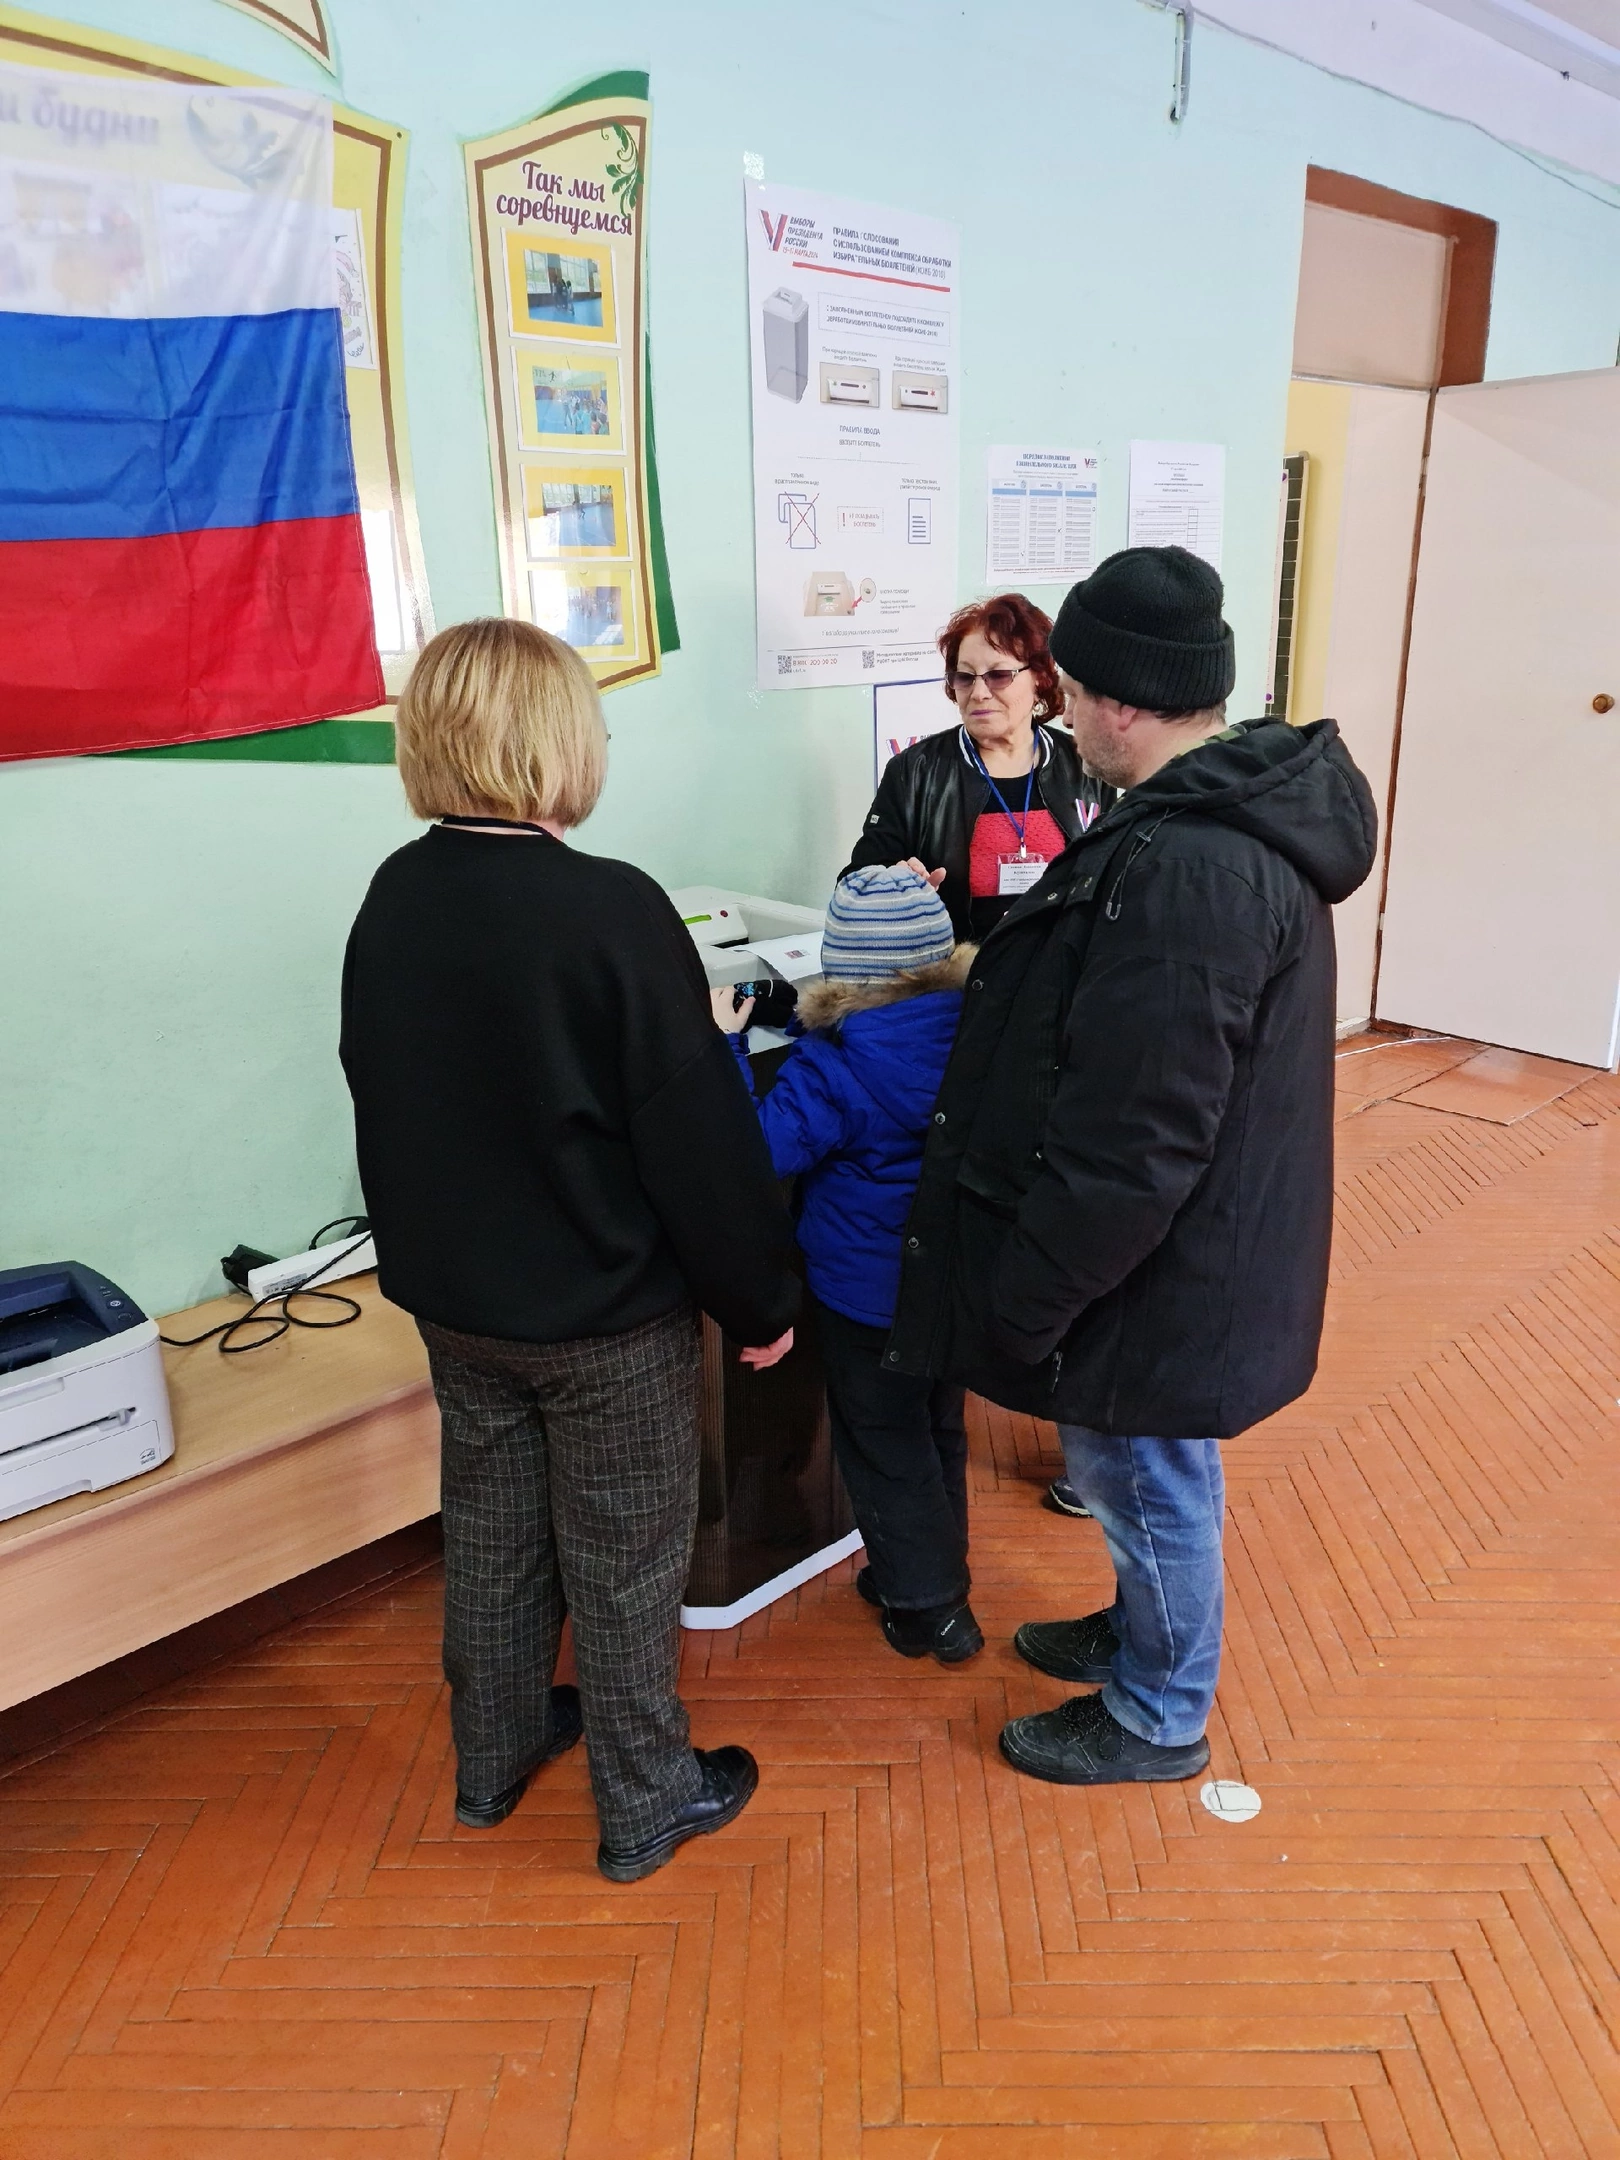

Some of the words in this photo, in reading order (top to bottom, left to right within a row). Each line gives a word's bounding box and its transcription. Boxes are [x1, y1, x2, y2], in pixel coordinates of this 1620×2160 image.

[522, 160, 563, 195] Так
[568, 178, 606, 203] мы
[496, 193, 633, 236] соревнуемся
